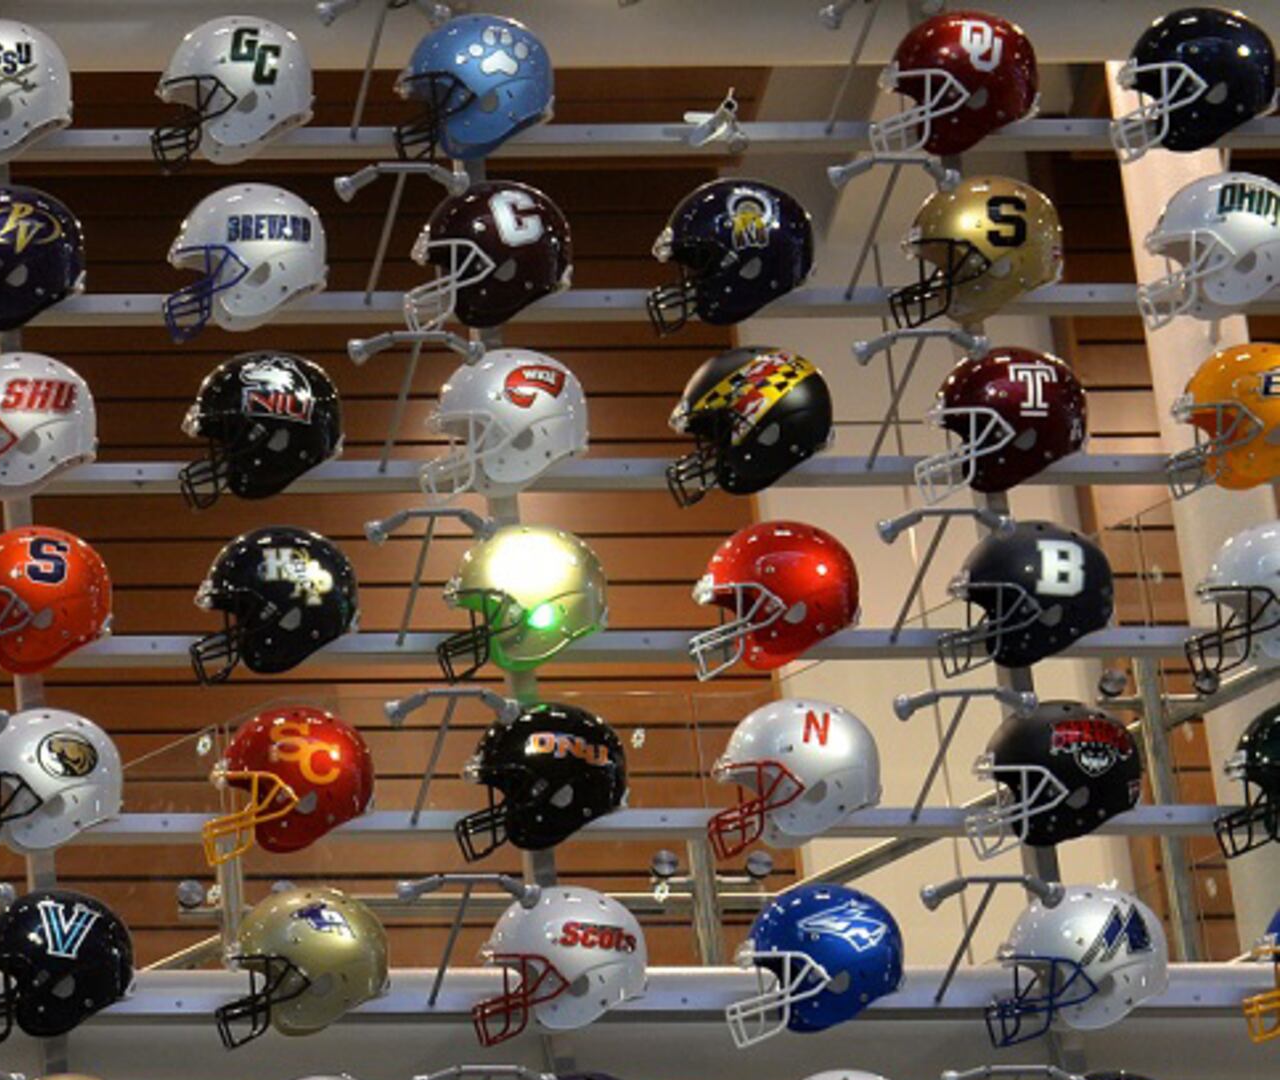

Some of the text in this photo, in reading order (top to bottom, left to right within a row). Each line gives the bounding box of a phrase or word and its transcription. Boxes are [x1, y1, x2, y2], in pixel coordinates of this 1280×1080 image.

[231, 28, 280, 84] GC
[961, 20, 1003, 70] OU
[226, 215, 311, 242] BREVARD
[490, 191, 542, 246] C
[987, 196, 1027, 246] S
[1, 379, 76, 412] SHU
[243, 388, 312, 424] NIU
[1009, 362, 1057, 416] T
[25, 538, 68, 584] S
[1037, 540, 1084, 596] B
[269, 722, 340, 783] SC
[802, 710, 831, 746] N
[38, 900, 99, 958] V
